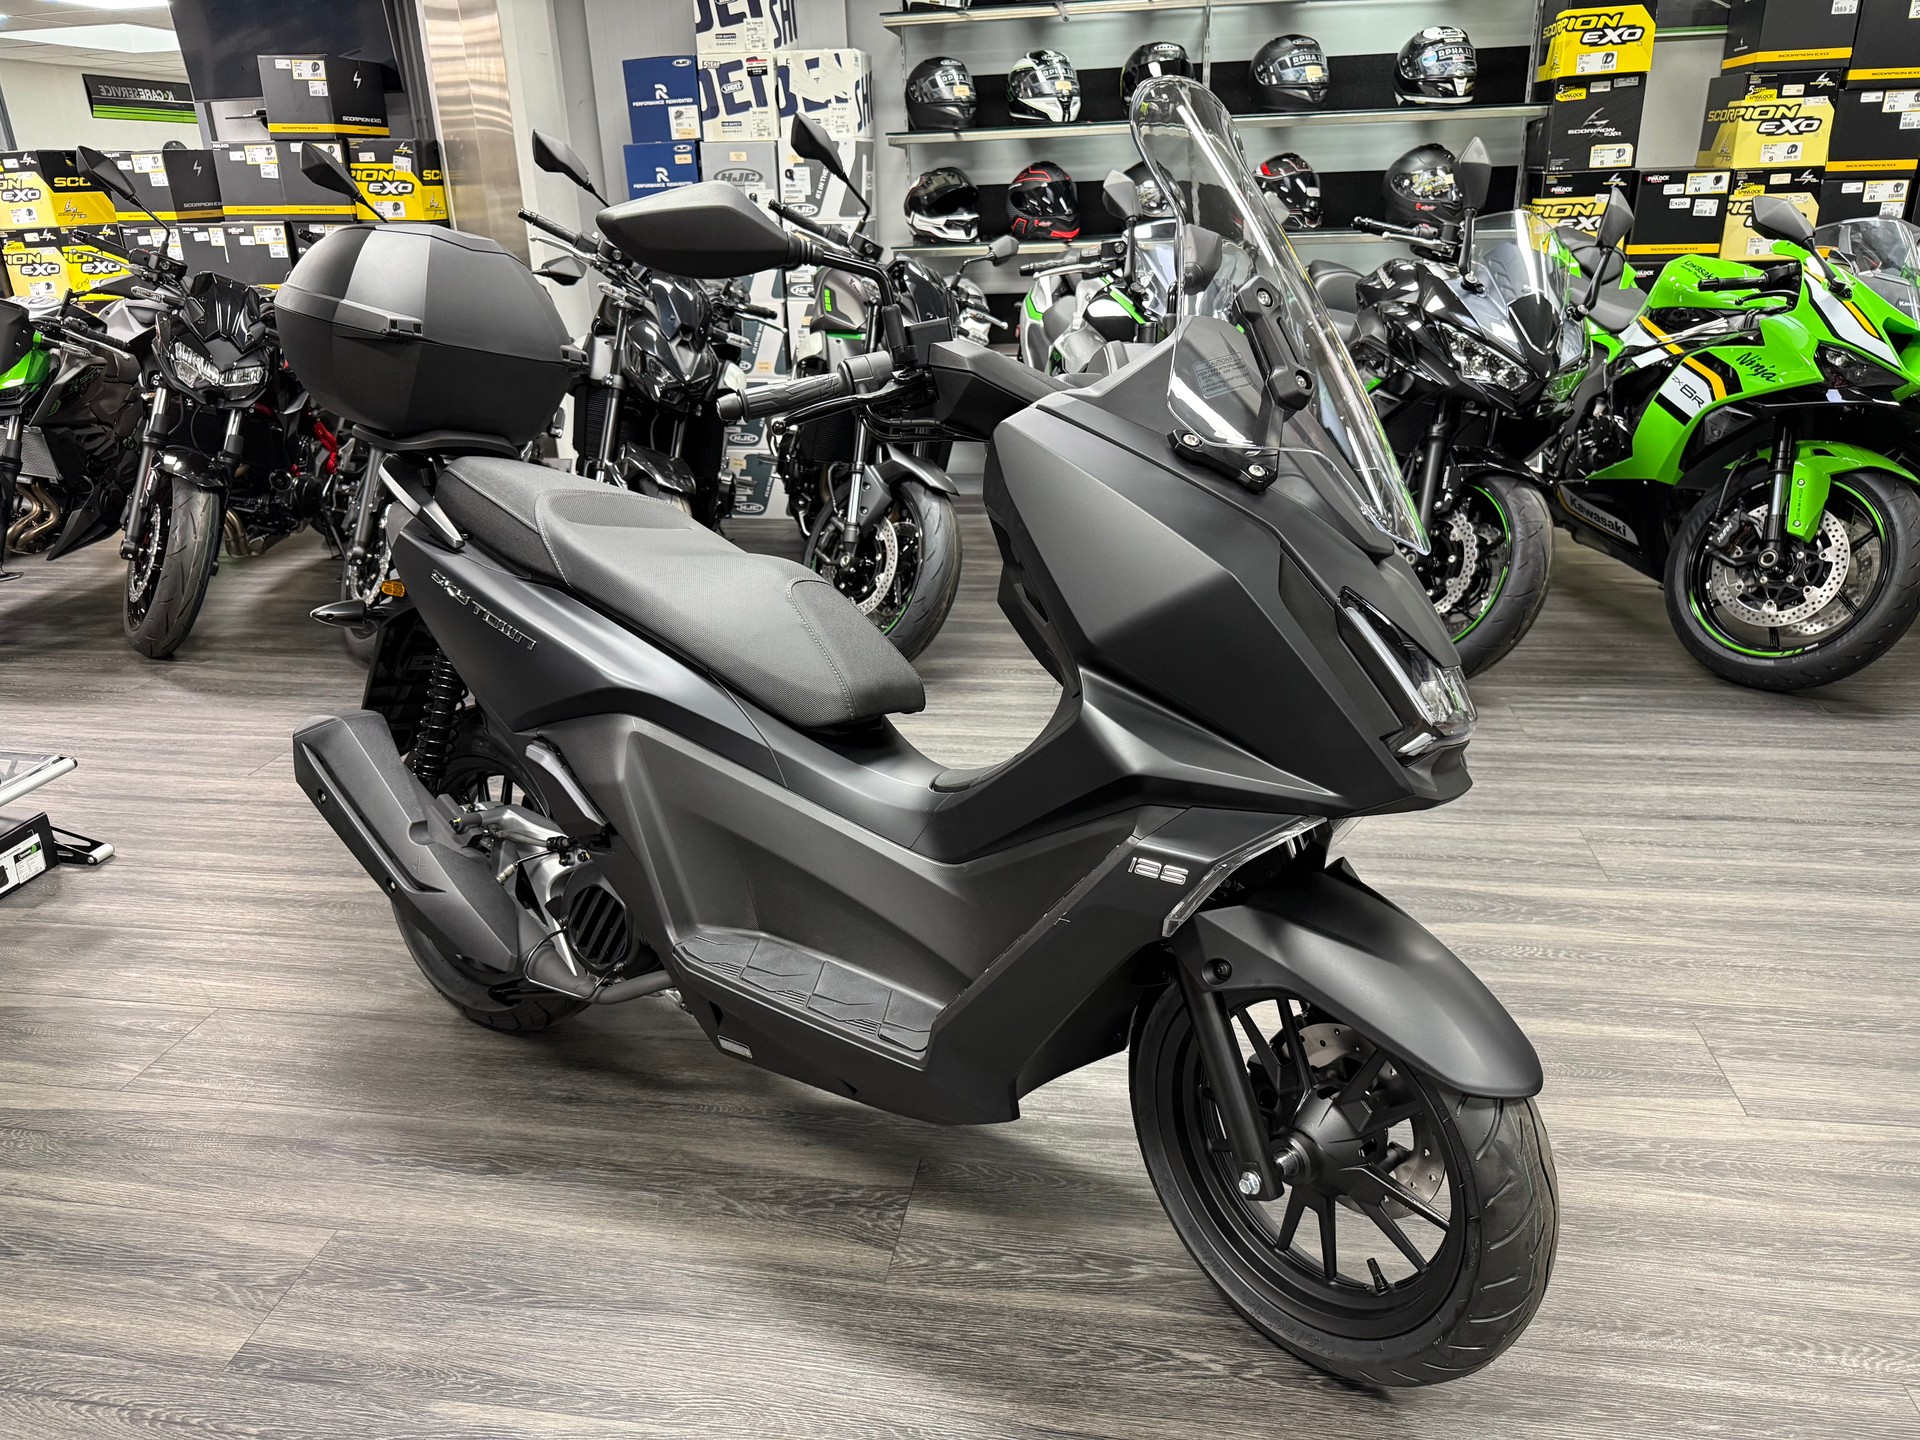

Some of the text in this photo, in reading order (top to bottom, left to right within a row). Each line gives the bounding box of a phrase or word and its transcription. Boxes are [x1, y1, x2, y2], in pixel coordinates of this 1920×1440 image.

[1543, 12, 1624, 39] SCORPION
[1293, 54, 1316, 65] RPHA
[1438, 47, 1464, 57] RPHA
[1707, 104, 1801, 122] SCORPION
[1567, 127, 1615, 135] SCORPION
[720, 172, 757, 182] HJC
[1684, 260, 1714, 279] Kawasak
[1736, 352, 1777, 383] Ninja
[1569, 495, 1626, 537] Kawasaki
[1128, 857, 1189, 885] 125
